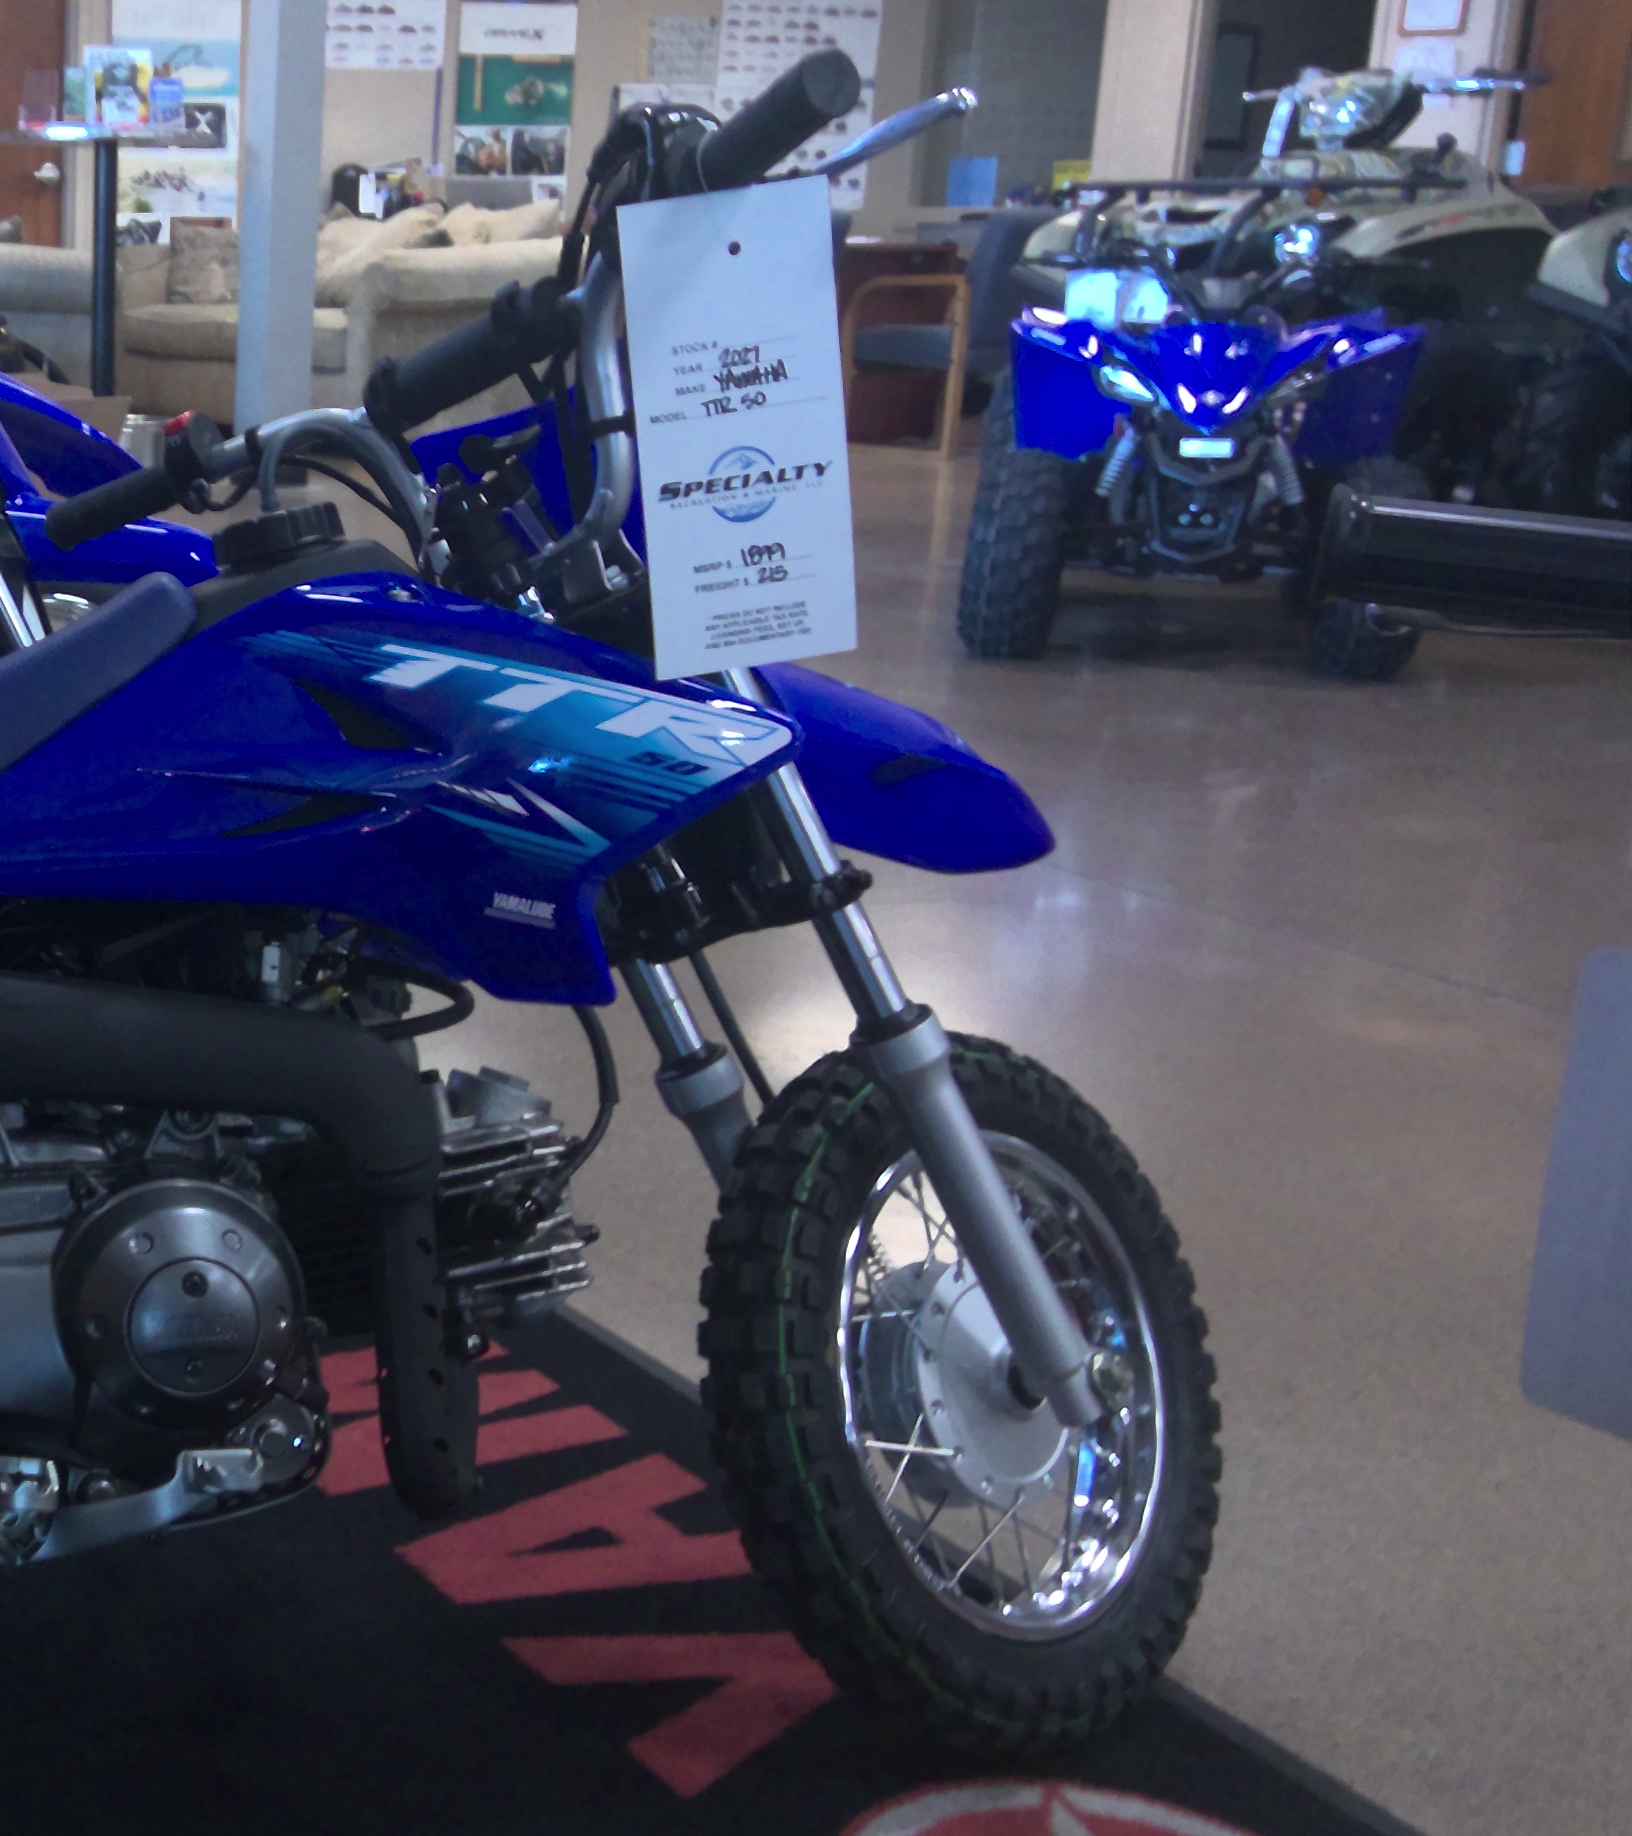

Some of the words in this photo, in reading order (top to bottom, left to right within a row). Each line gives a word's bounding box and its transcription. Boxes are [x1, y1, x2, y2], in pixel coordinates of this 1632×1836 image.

[671, 342, 708, 356] STOCK
[673, 363, 704, 375] YEAR
[675, 383, 706, 396] MAKE
[649, 411, 687, 424] MODEL
[701, 395, 738, 417] TTR
[740, 390, 767, 410] 50
[657, 460, 833, 502] SPECIALTY
[693, 561, 724, 574] MSRP
[740, 542, 786, 567] 1899
[694, 578, 740, 593] FREIGHT
[368, 643, 792, 768] TTR
